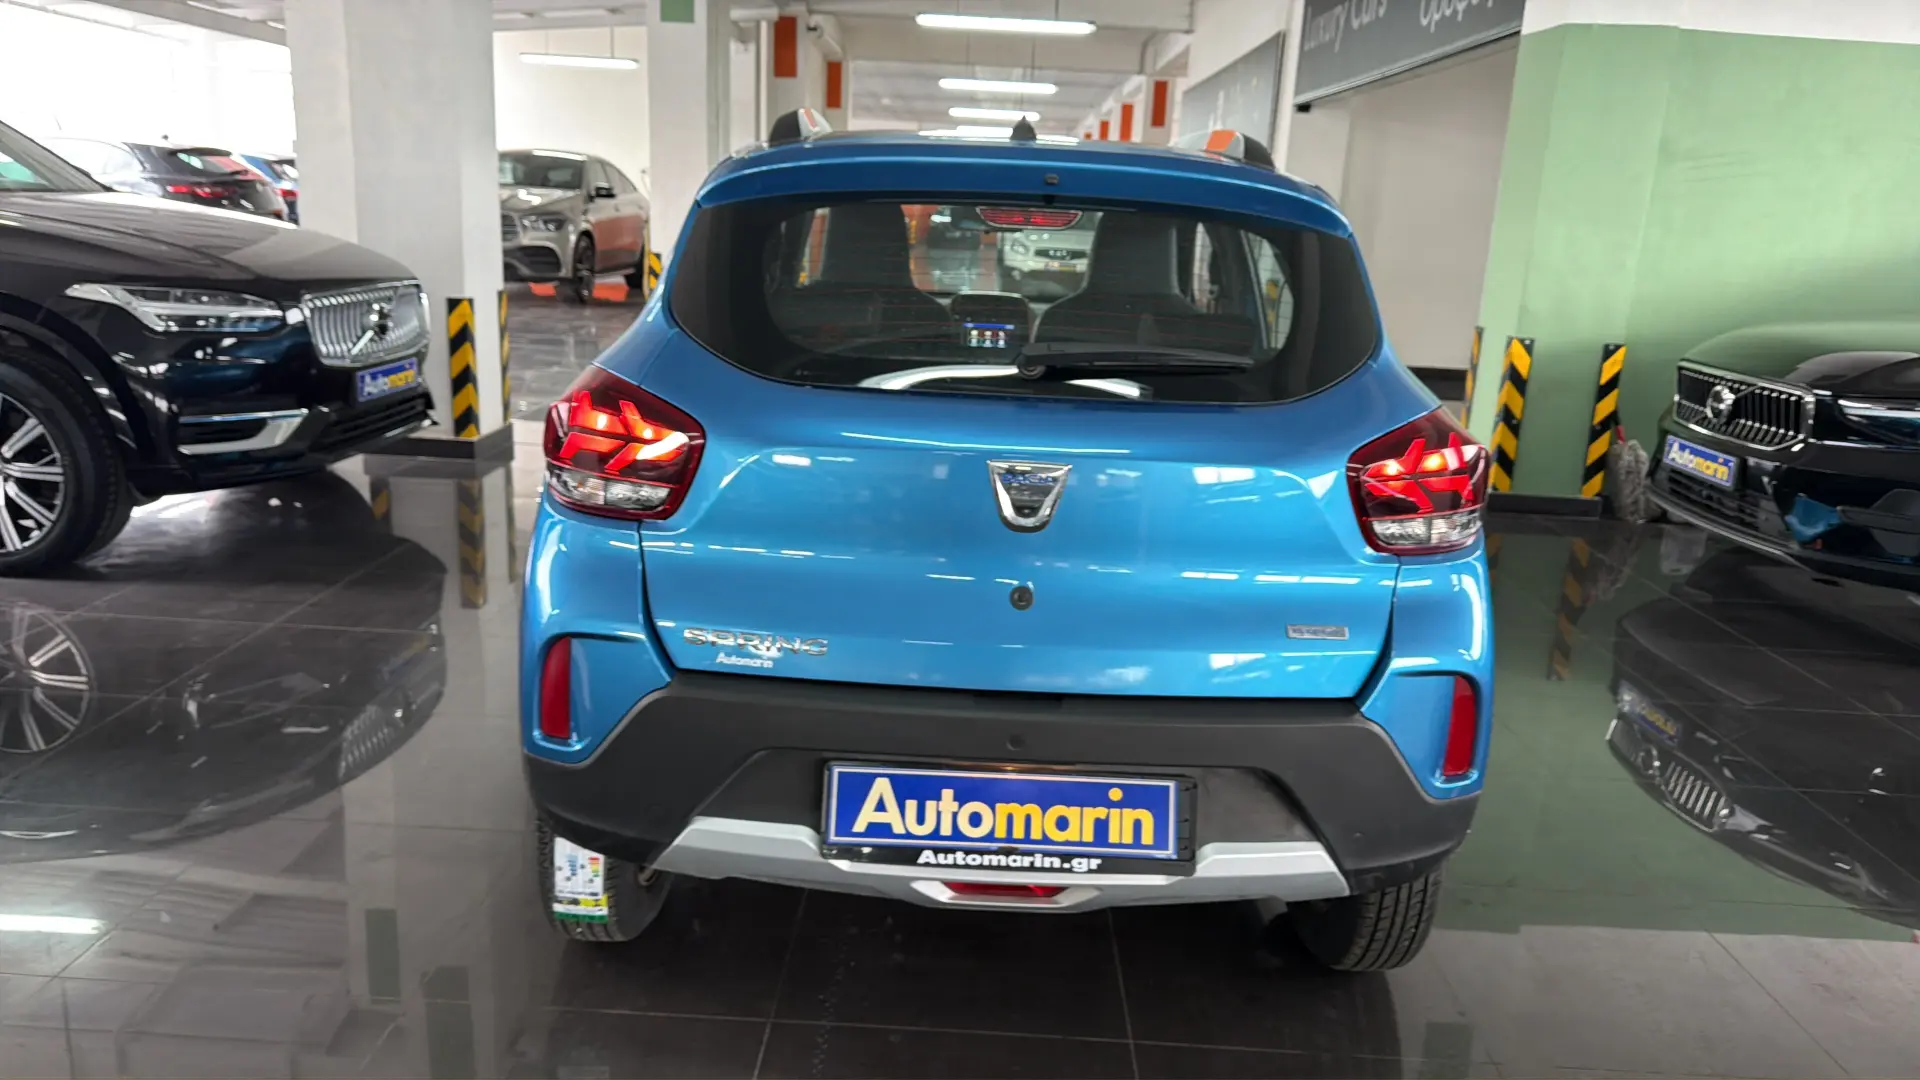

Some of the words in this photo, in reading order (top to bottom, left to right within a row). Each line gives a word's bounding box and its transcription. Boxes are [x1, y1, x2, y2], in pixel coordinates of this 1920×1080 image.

[1668, 440, 1729, 481] Automarin
[716, 651, 774, 668] Automarin
[852, 777, 1155, 845] Automarin
[916, 850, 1103, 872] Automarin.gr
